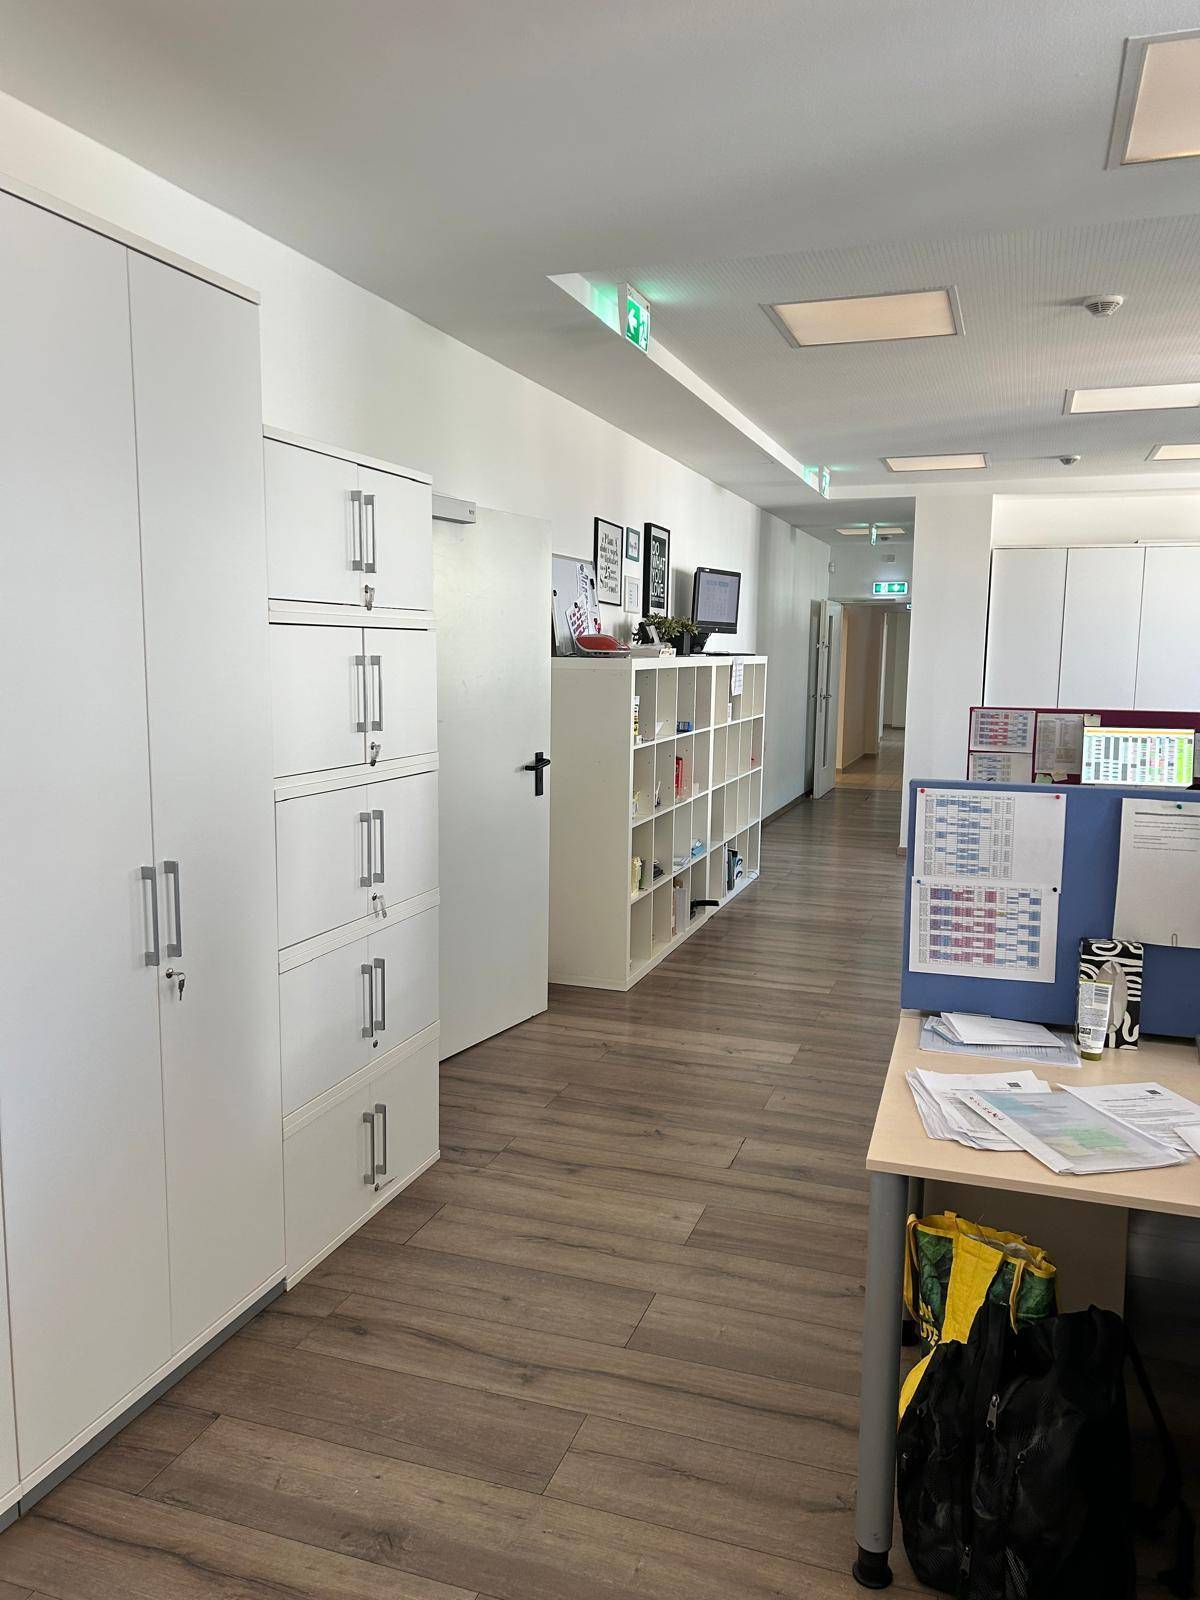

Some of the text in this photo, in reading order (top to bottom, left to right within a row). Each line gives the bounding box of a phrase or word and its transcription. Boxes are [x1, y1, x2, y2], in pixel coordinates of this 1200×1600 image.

[652, 540, 660, 556] DO
[651, 554, 666, 571] WHAT
[651, 569, 663, 584] YOU
[651, 582, 664, 597] LOVE
